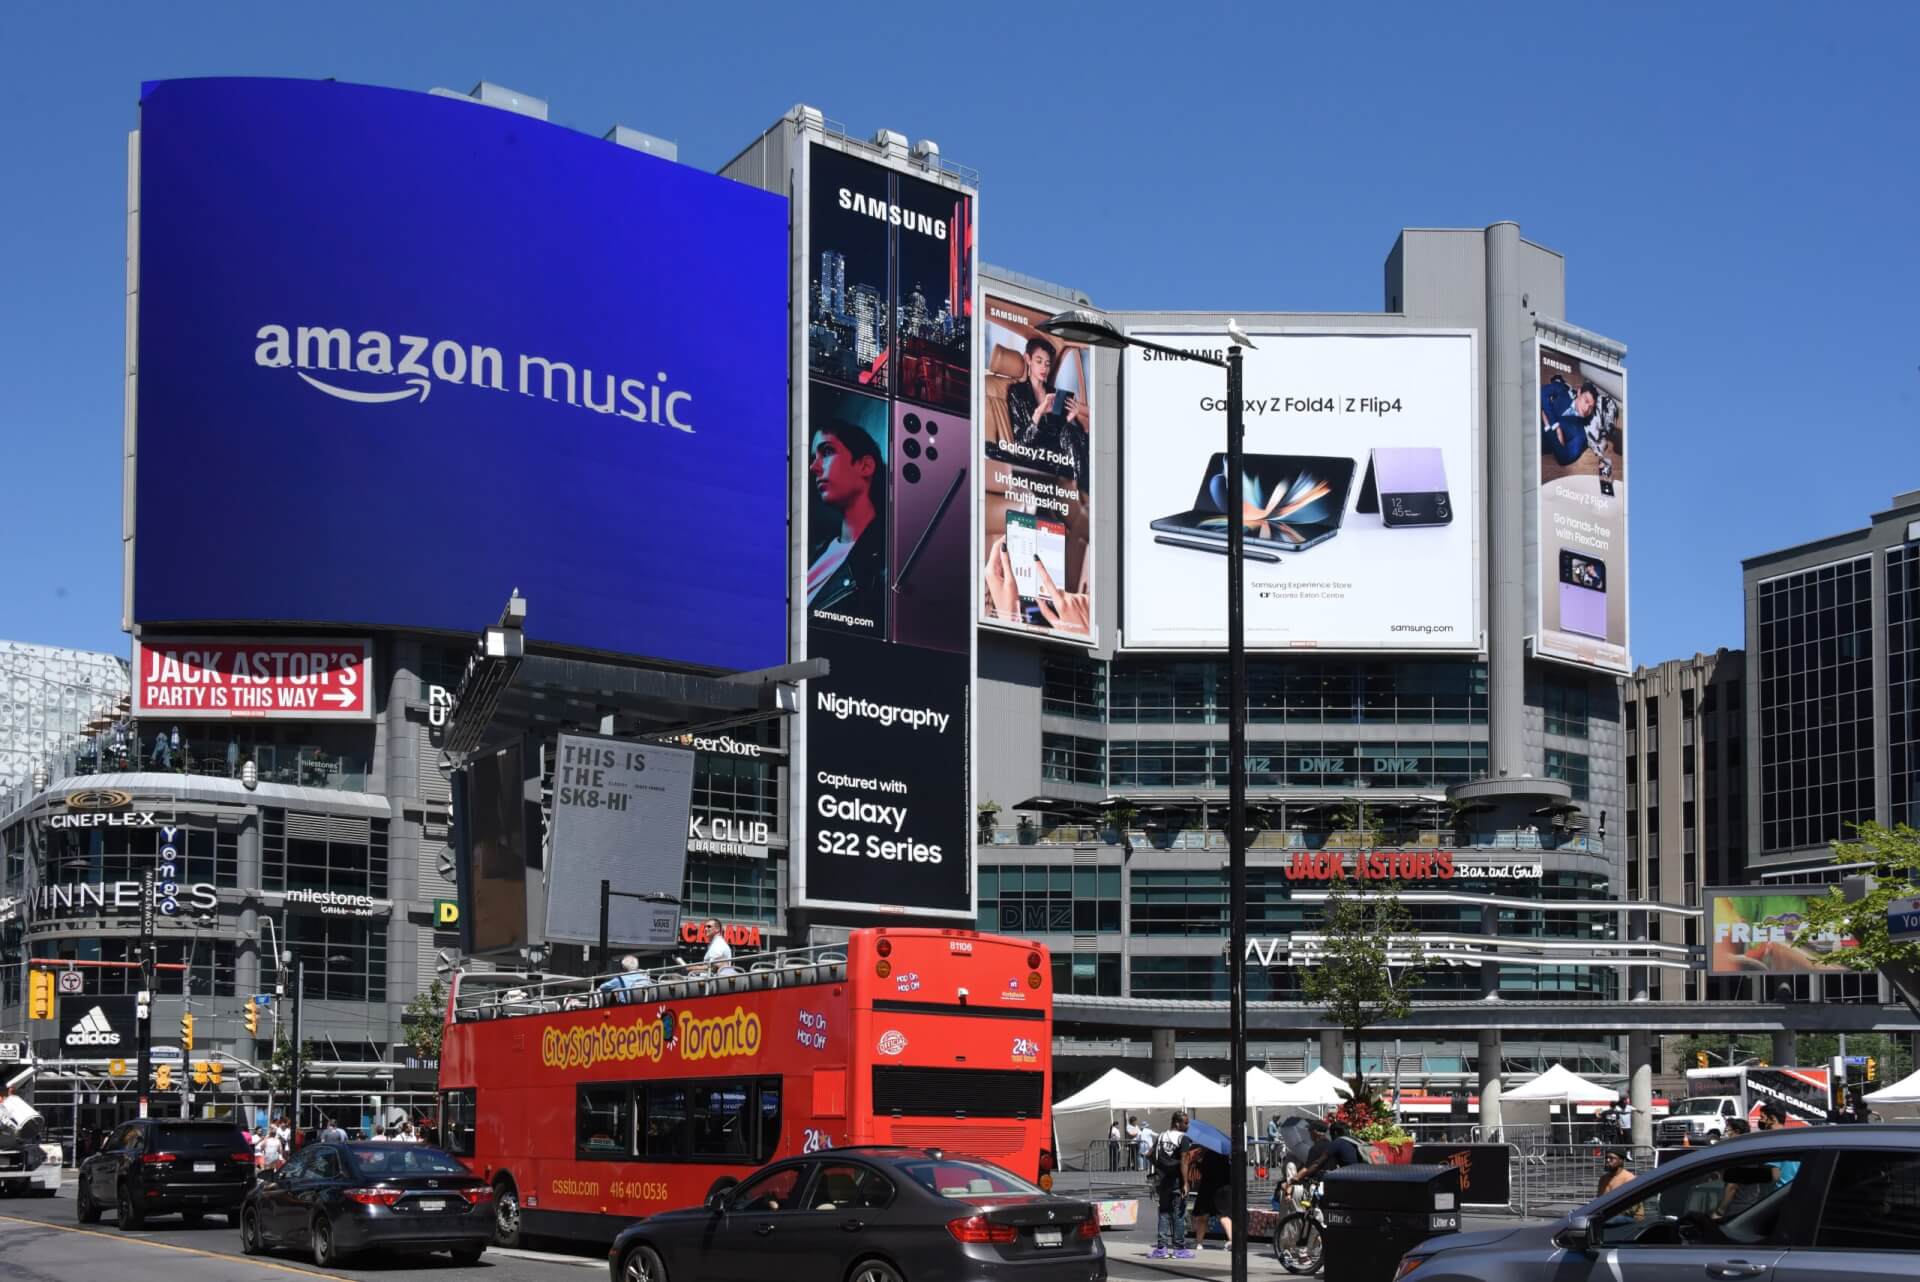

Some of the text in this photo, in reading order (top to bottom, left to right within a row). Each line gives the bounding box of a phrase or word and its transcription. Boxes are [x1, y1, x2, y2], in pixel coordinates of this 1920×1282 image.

[838, 187, 948, 241] SAMSUNG
[989, 307, 1029, 325] SAMSUNG
[254, 323, 696, 433] amazon music
[1200, 396, 1403, 417] Gaxy Z Fold4 Z Flip4
[998, 438, 1075, 467] Galaxy Z Fold4
[994, 471, 1080, 501] Unfold next level
[1555, 484, 1583, 504] Galaxy
[1004, 487, 1069, 515] multitasking
[1554, 512, 1611, 539] Go hands-free
[1556, 527, 1609, 550] with FlexCam
[813, 608, 874, 628] samsung.com
[1390, 622, 1454, 634] samsung.com
[147, 650, 357, 686] JACK ASTOR'S
[147, 686, 318, 708] PARTY IS THIS WAY
[817, 691, 950, 733] Nightography
[564, 745, 646, 772] THIS IS
[1226, 758, 1419, 772] MZ DMZ DMZ
[562, 766, 605, 788] THE
[817, 771, 907, 794] Captured with
[51, 812, 155, 828] CINEPLEX
[817, 794, 907, 832] Galaxy
[712, 818, 768, 845] CLUB
[817, 830, 943, 864] S22 Series
[1284, 851, 1346, 880] JACK
[1354, 849, 1456, 880] ASTOR'S
[145, 871, 153, 935] DOWNTOWN
[287, 888, 374, 907] milestones
[681, 921, 761, 946] CAADA
[800, 1009, 827, 1030] Hop On
[65, 1029, 121, 1045] adidas
[543, 1006, 760, 1069] CitySightseeing Toronto
[797, 1028, 828, 1049] Hop Off
[1747, 1079, 1828, 1119] BATTLE CANADA
[552, 1177, 668, 1201] cssto.com 416 410 0536
